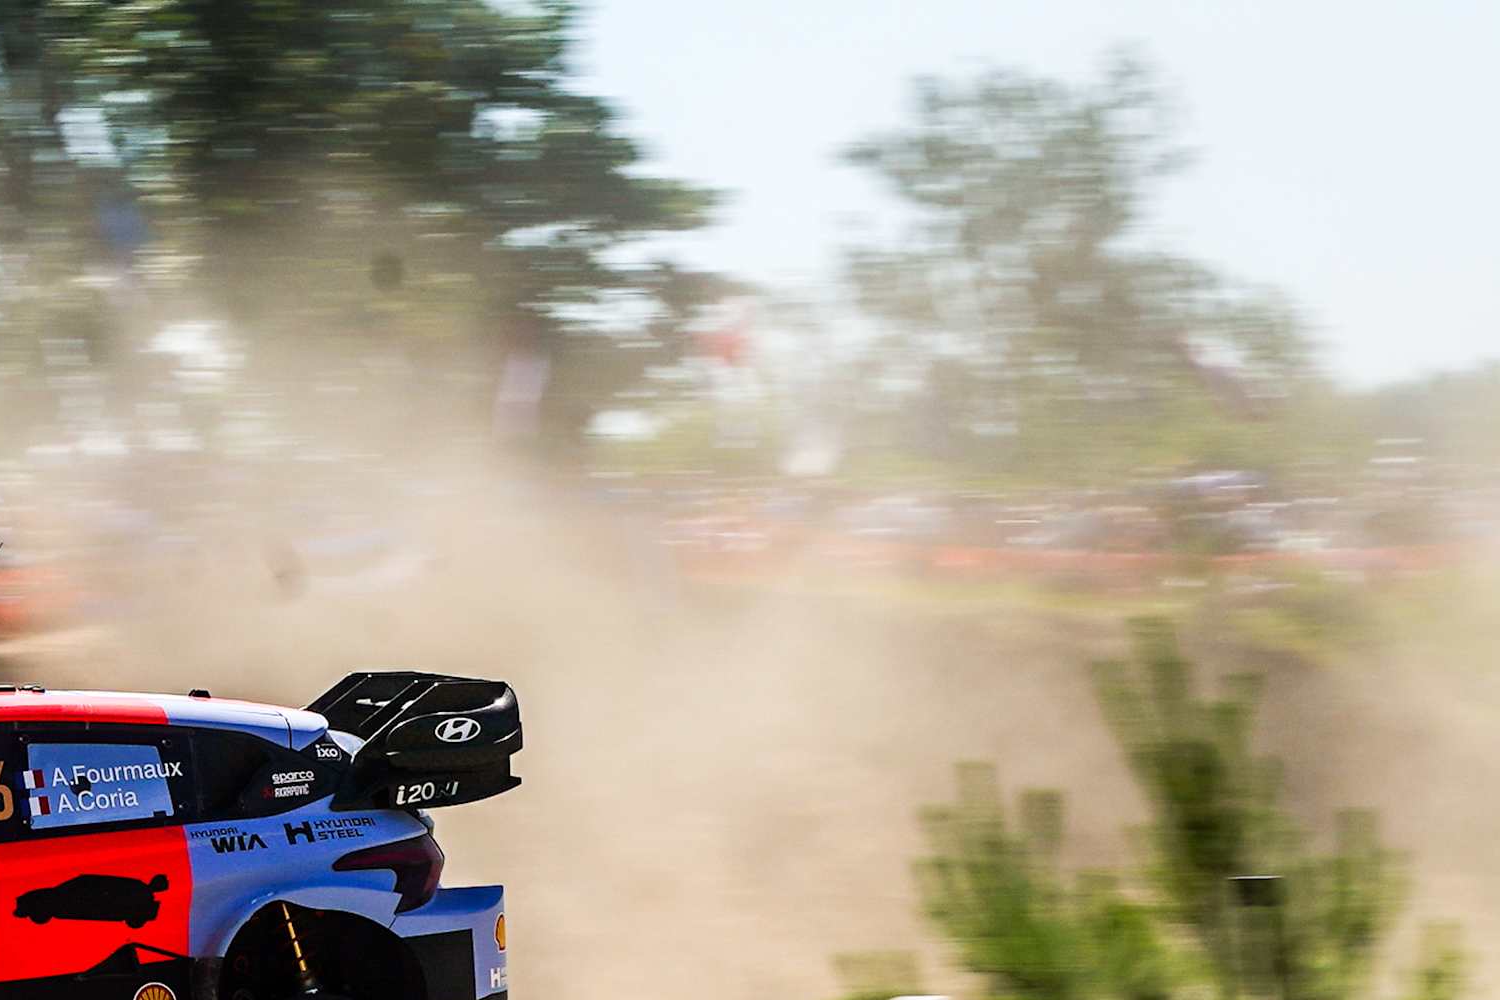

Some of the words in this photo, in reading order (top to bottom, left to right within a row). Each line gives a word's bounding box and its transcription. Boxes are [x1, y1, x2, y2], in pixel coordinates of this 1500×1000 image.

[51, 761, 184, 788] A.Fourmaux
[271, 770, 315, 785] sparco
[57, 788, 139, 814] A.Coria
[396, 782, 436, 805] i20
[313, 817, 377, 830] HYUNDAI
[190, 827, 240, 839] HYUNDAI
[317, 829, 365, 841] STEEL
